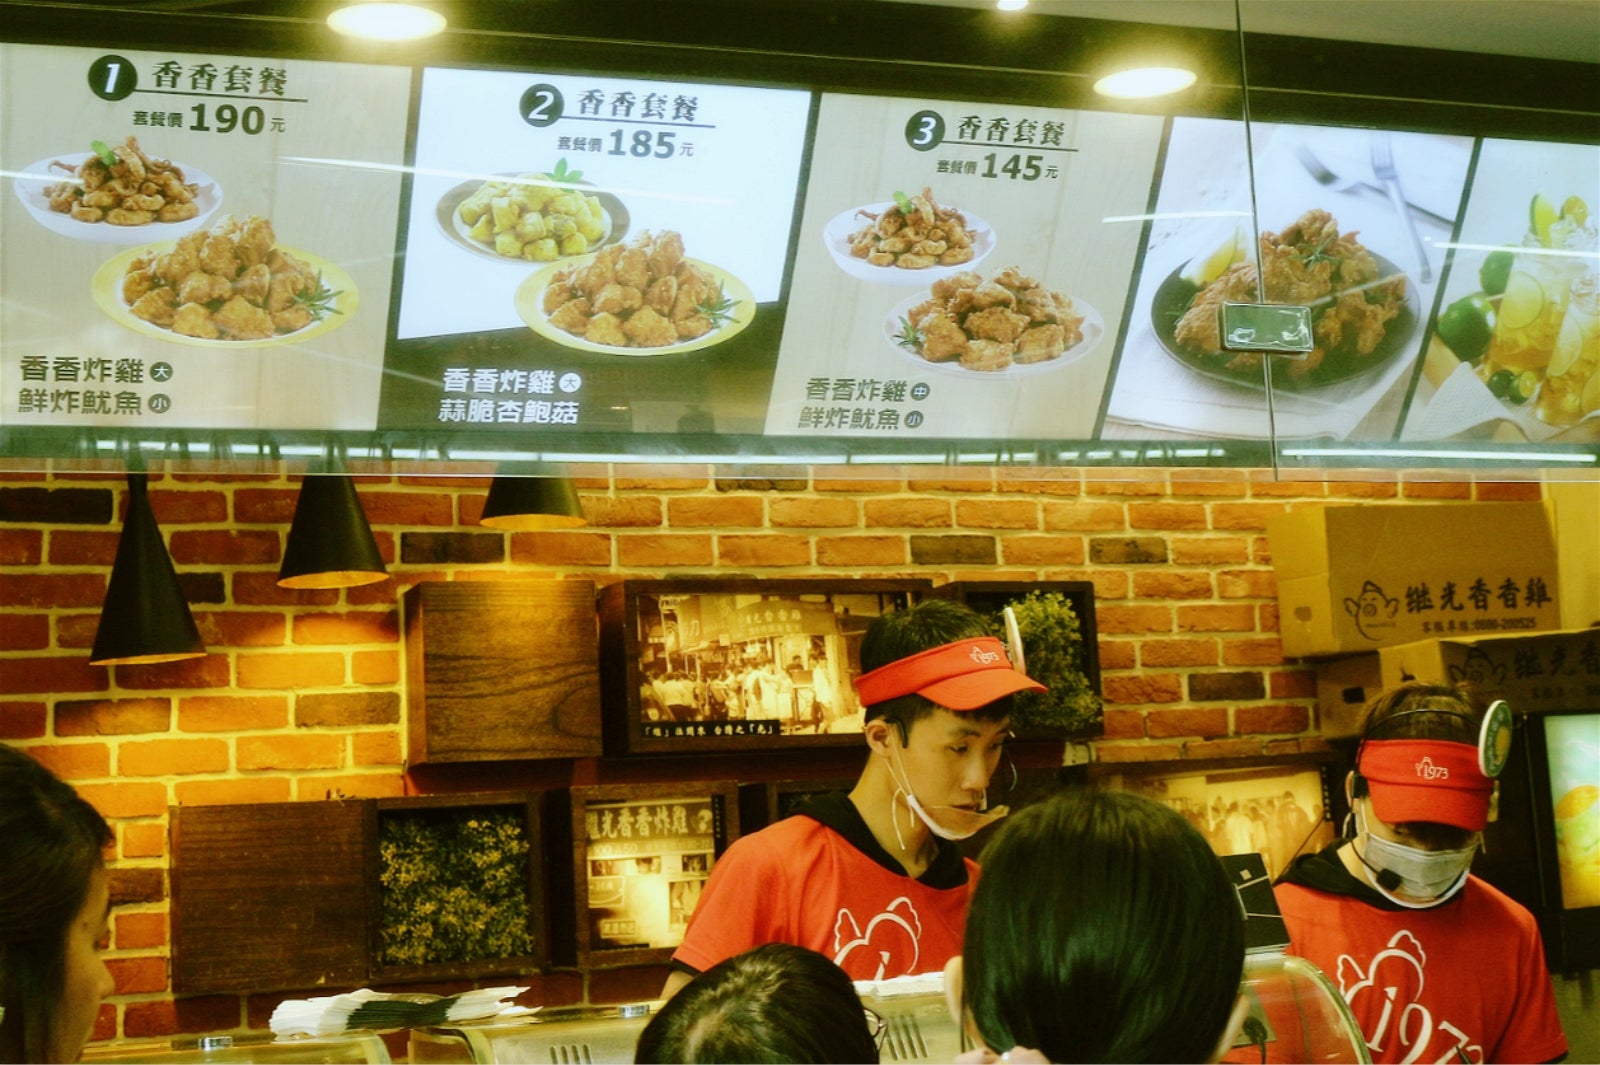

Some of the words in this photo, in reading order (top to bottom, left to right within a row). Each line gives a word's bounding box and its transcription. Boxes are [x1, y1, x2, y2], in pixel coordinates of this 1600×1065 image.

[104, 63, 121, 94] 1
[152, 61, 288, 96] 香香套餐
[528, 91, 555, 121] 2
[578, 89, 698, 121] 香香套餐
[913, 117, 937, 145] 3
[958, 115, 1065, 146] 香香套餐
[20, 355, 144, 384] 香香炸雞
[443, 368, 556, 394] 香香炸雞
[18, 388, 143, 415] 鮮炸魷魚
[806, 377, 908, 402] 香香炸雞
[438, 398, 580, 424] 蒜脆杏鮑菇
[798, 406, 900, 430] 鮮炸魷魚
